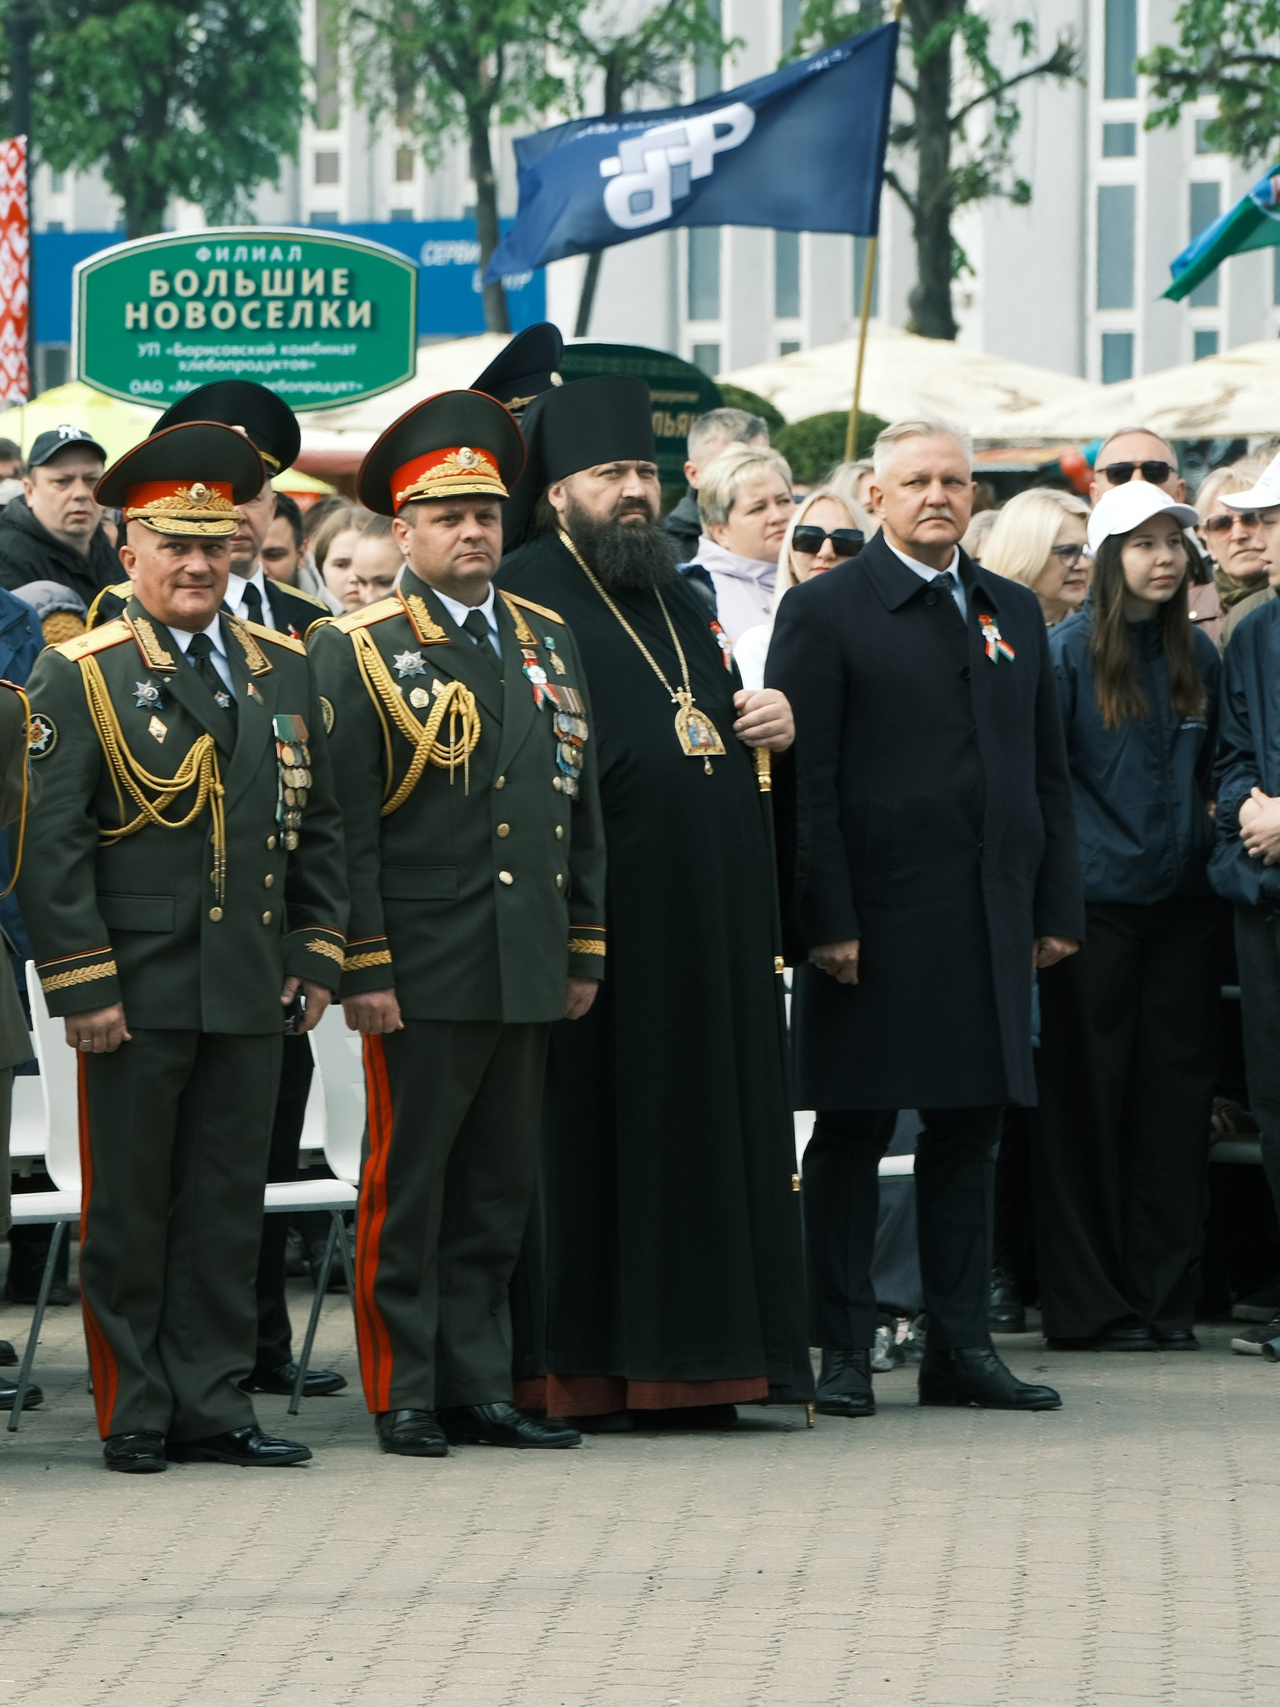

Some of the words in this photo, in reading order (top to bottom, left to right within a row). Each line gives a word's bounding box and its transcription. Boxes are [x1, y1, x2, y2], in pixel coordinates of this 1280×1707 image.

[195, 245, 303, 263] ФИЛИАЛ
[420, 239, 482, 267] СЕРВИ
[149, 268, 349, 297] БОЛЬШИЕ
[125, 300, 372, 330] НОВОСЕЛКИ
[137, 341, 161, 358] УП
[280, 341, 358, 356] комбинат
[129, 379, 164, 394] ОАО
